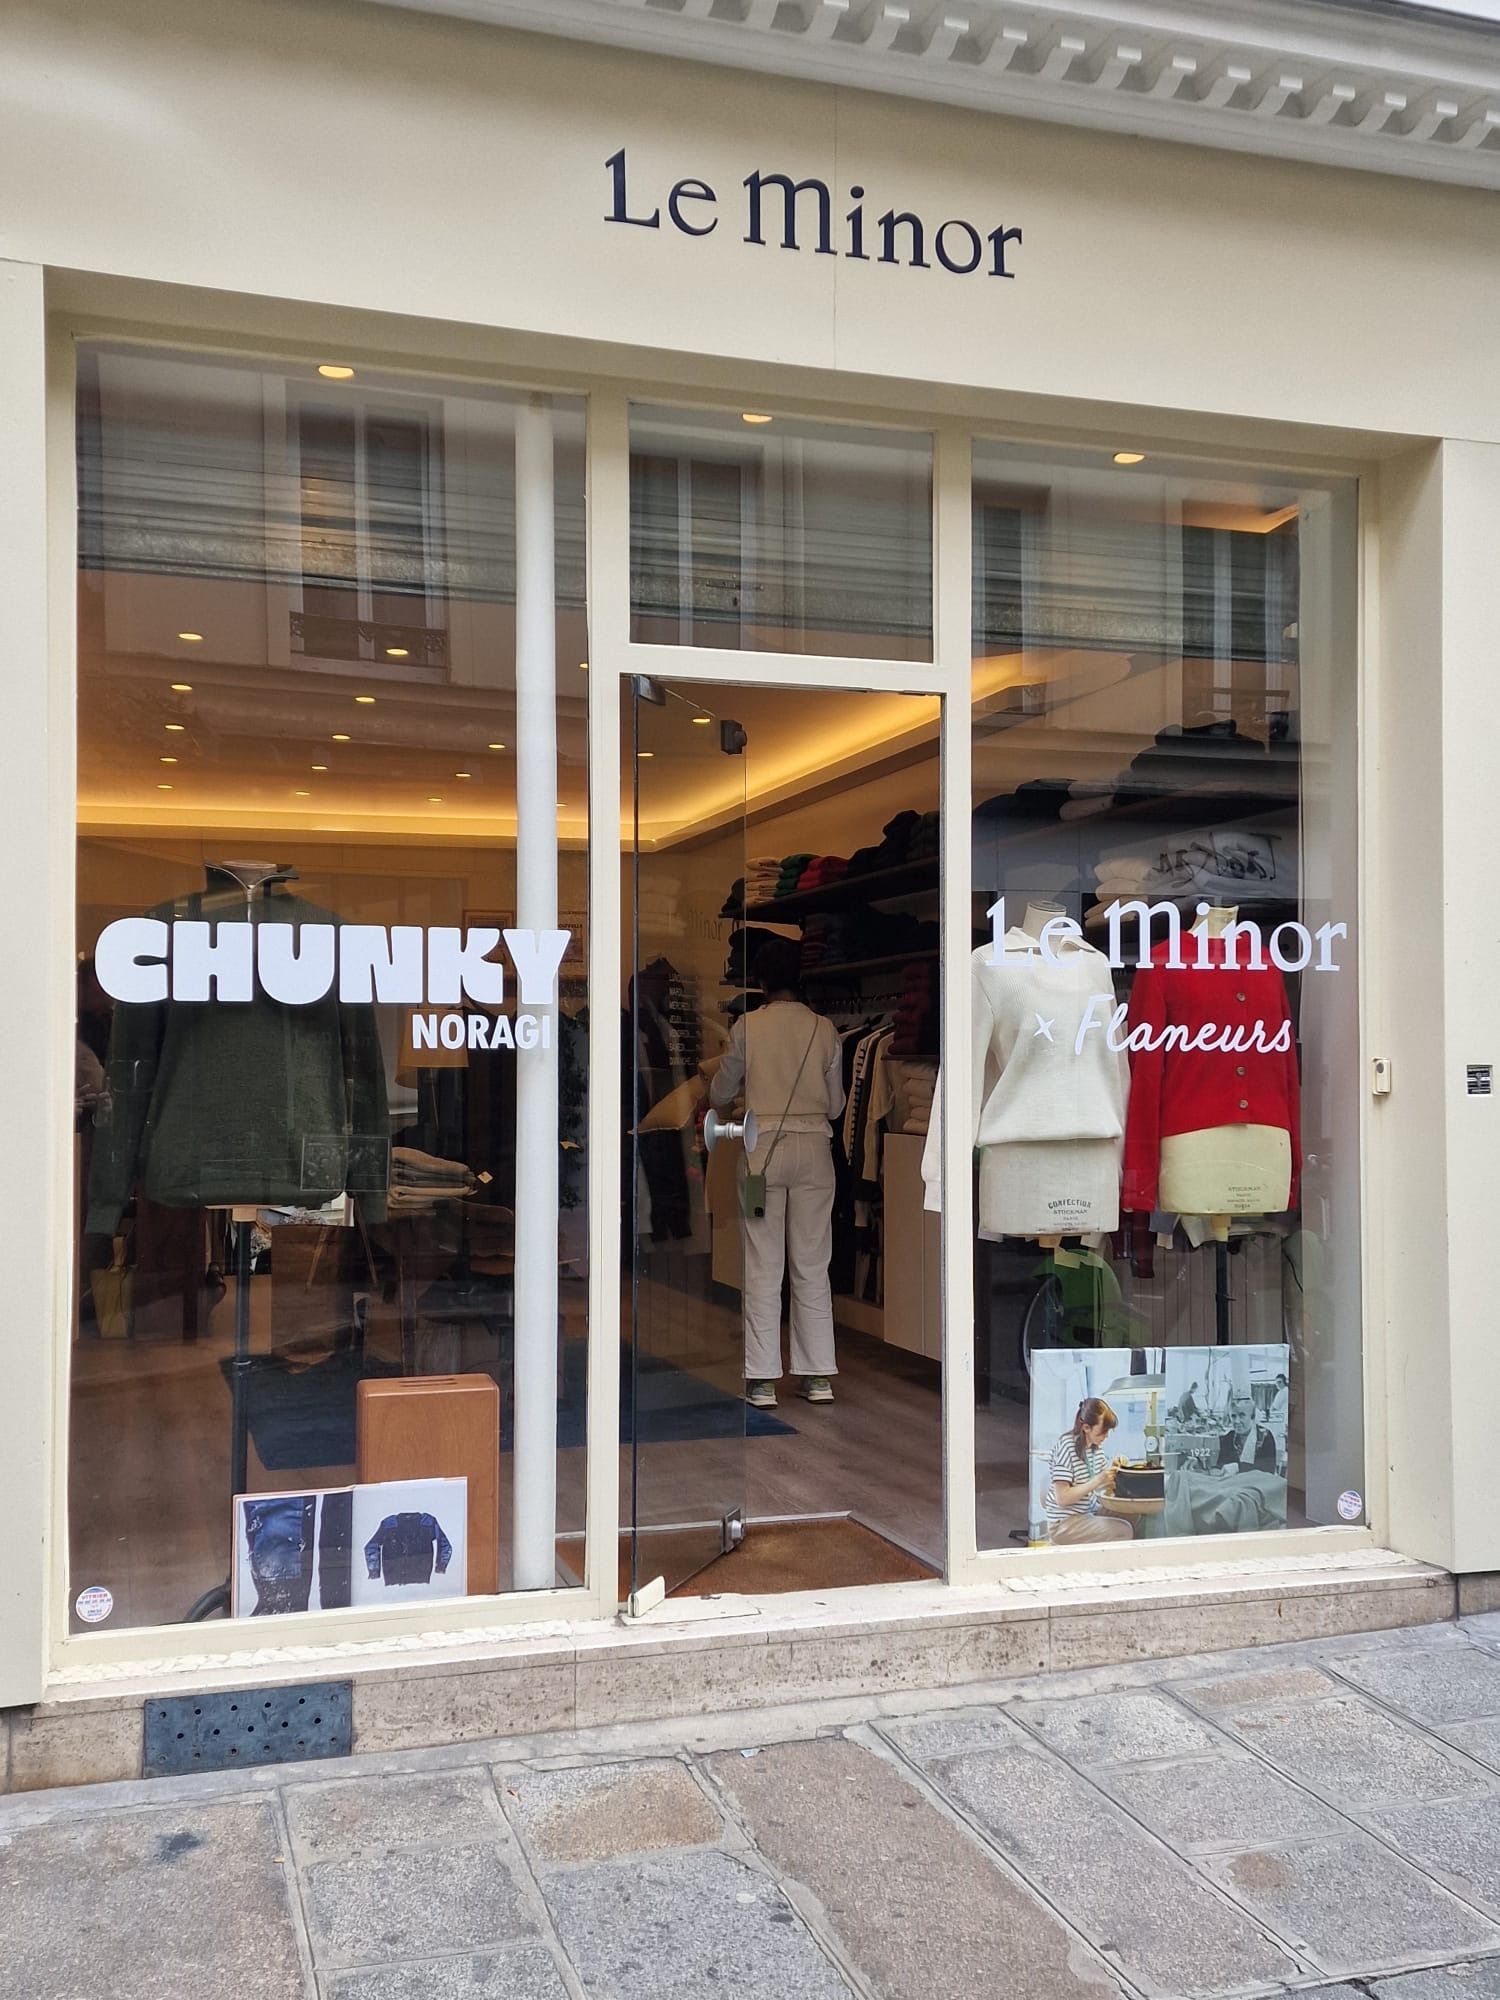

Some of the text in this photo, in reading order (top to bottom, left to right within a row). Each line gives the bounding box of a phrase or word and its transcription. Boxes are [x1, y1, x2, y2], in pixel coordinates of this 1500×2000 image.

[604, 147, 719, 236] Le
[94, 916, 572, 1006] CHUNKY
[985, 896, 1084, 969] Le
[411, 1013, 551, 1050] NORAGI
[1074, 993, 1292, 1055] Flaneurs
[1190, 1447, 1211, 1457] 1922
